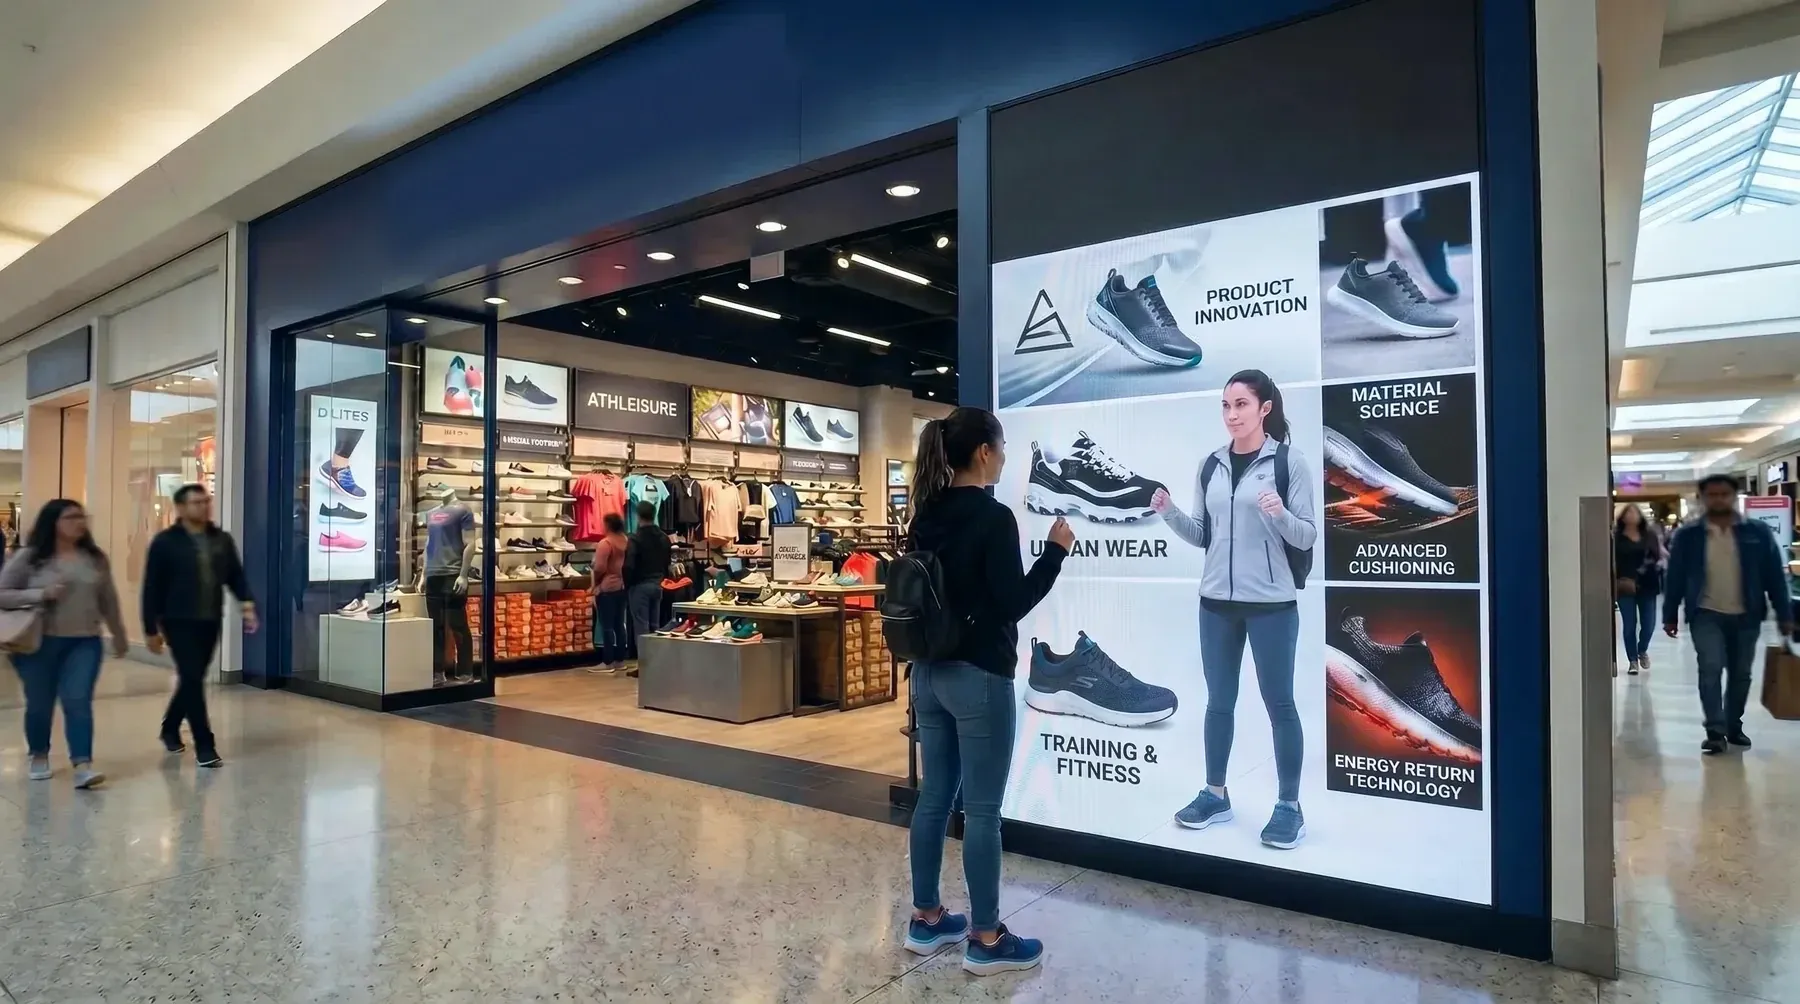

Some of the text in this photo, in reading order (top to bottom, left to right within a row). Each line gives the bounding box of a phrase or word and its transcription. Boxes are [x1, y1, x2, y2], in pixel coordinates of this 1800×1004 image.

[1207, 278, 1295, 304] PRODUCT
[1195, 296, 1308, 326] INNOVATION
[587, 391, 677, 417] ATHLEISURE
[1352, 381, 1448, 403] MATERIAL
[318, 407, 369, 423] D LITES
[1359, 399, 1440, 419] SCIENCE
[1030, 539, 1168, 558] UAN WEAR
[1355, 543, 1447, 558] ADVANCED
[1348, 560, 1455, 575] CUSHIONING
[1041, 733, 1158, 763] TRAINING &
[1057, 757, 1141, 786] FITNESS
[1335, 754, 1475, 784] ENERGY RETURN
[1346, 773, 1463, 800] TECHNOLOGY
